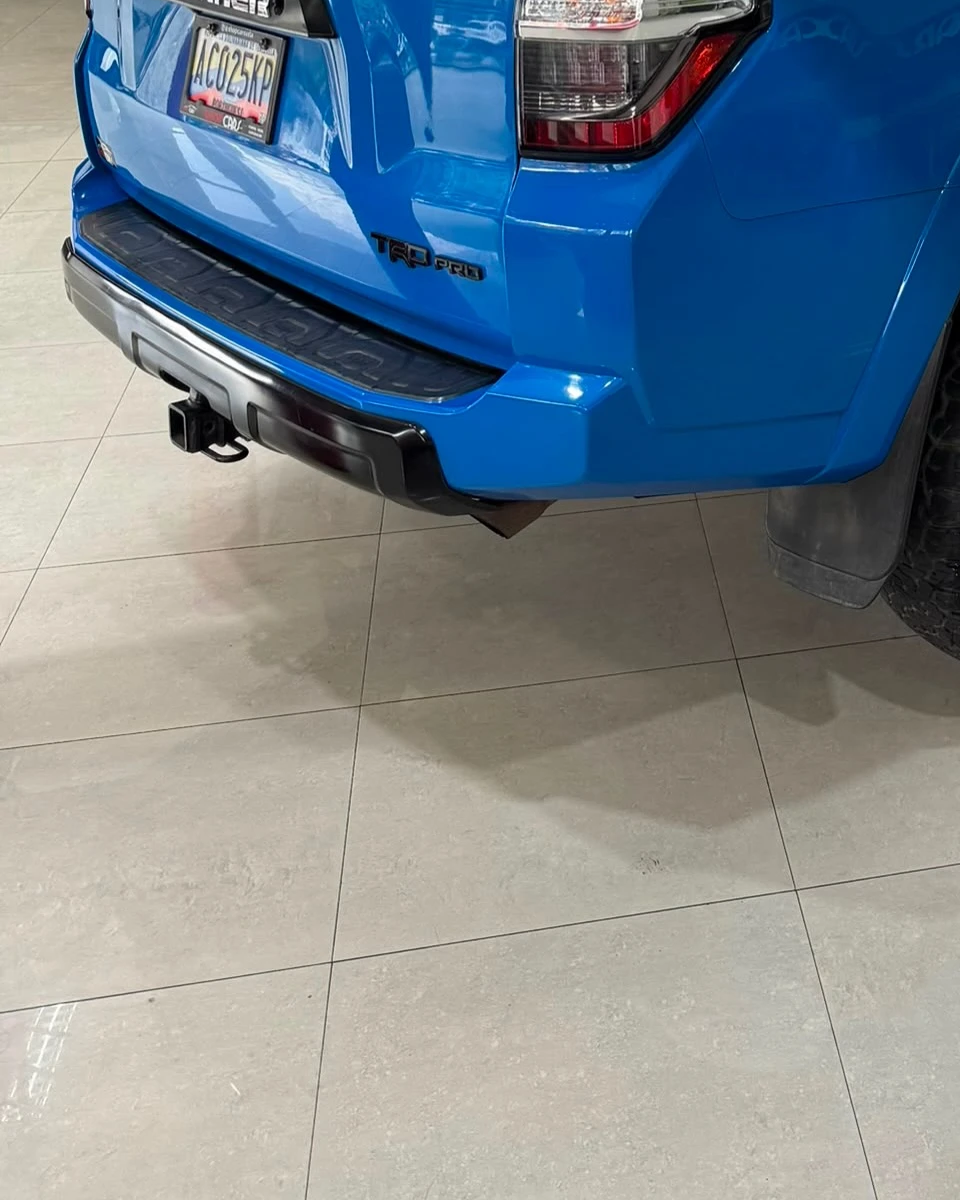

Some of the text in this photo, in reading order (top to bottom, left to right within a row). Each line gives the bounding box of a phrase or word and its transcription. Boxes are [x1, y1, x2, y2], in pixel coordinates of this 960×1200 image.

[193, 38, 274, 108] AC025KP
[370, 232, 486, 281] TRD PRO
